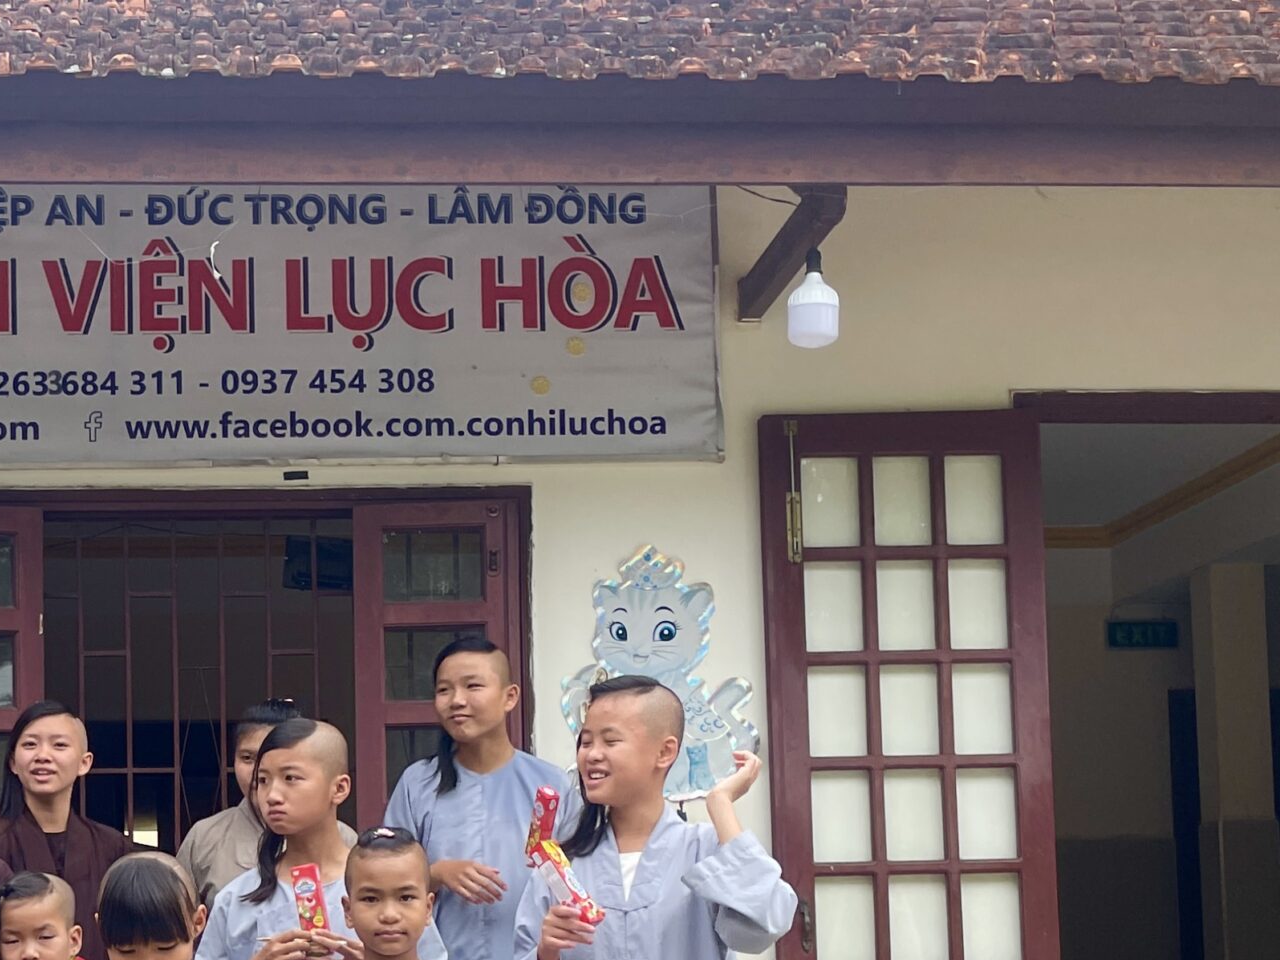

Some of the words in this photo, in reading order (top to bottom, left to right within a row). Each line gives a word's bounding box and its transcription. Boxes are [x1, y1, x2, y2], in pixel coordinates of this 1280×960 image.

[45, 193, 106, 226] AN
[145, 186, 234, 226] ĐỨC
[244, 192, 387, 232] TRỌNG
[427, 184, 513, 225] LÂM
[525, 184, 647, 225] ĐỒNG
[42, 236, 255, 353] VIỆN
[286, 256, 455, 352] LỤC
[480, 234, 685, 333] HÒA
[129, 370, 184, 395] 311
[221, 370, 298, 395] 0937
[309, 369, 367, 394] 454
[378, 368, 435, 393] 308
[125, 409, 667, 440] www.facebook.com.conhiluchoa
